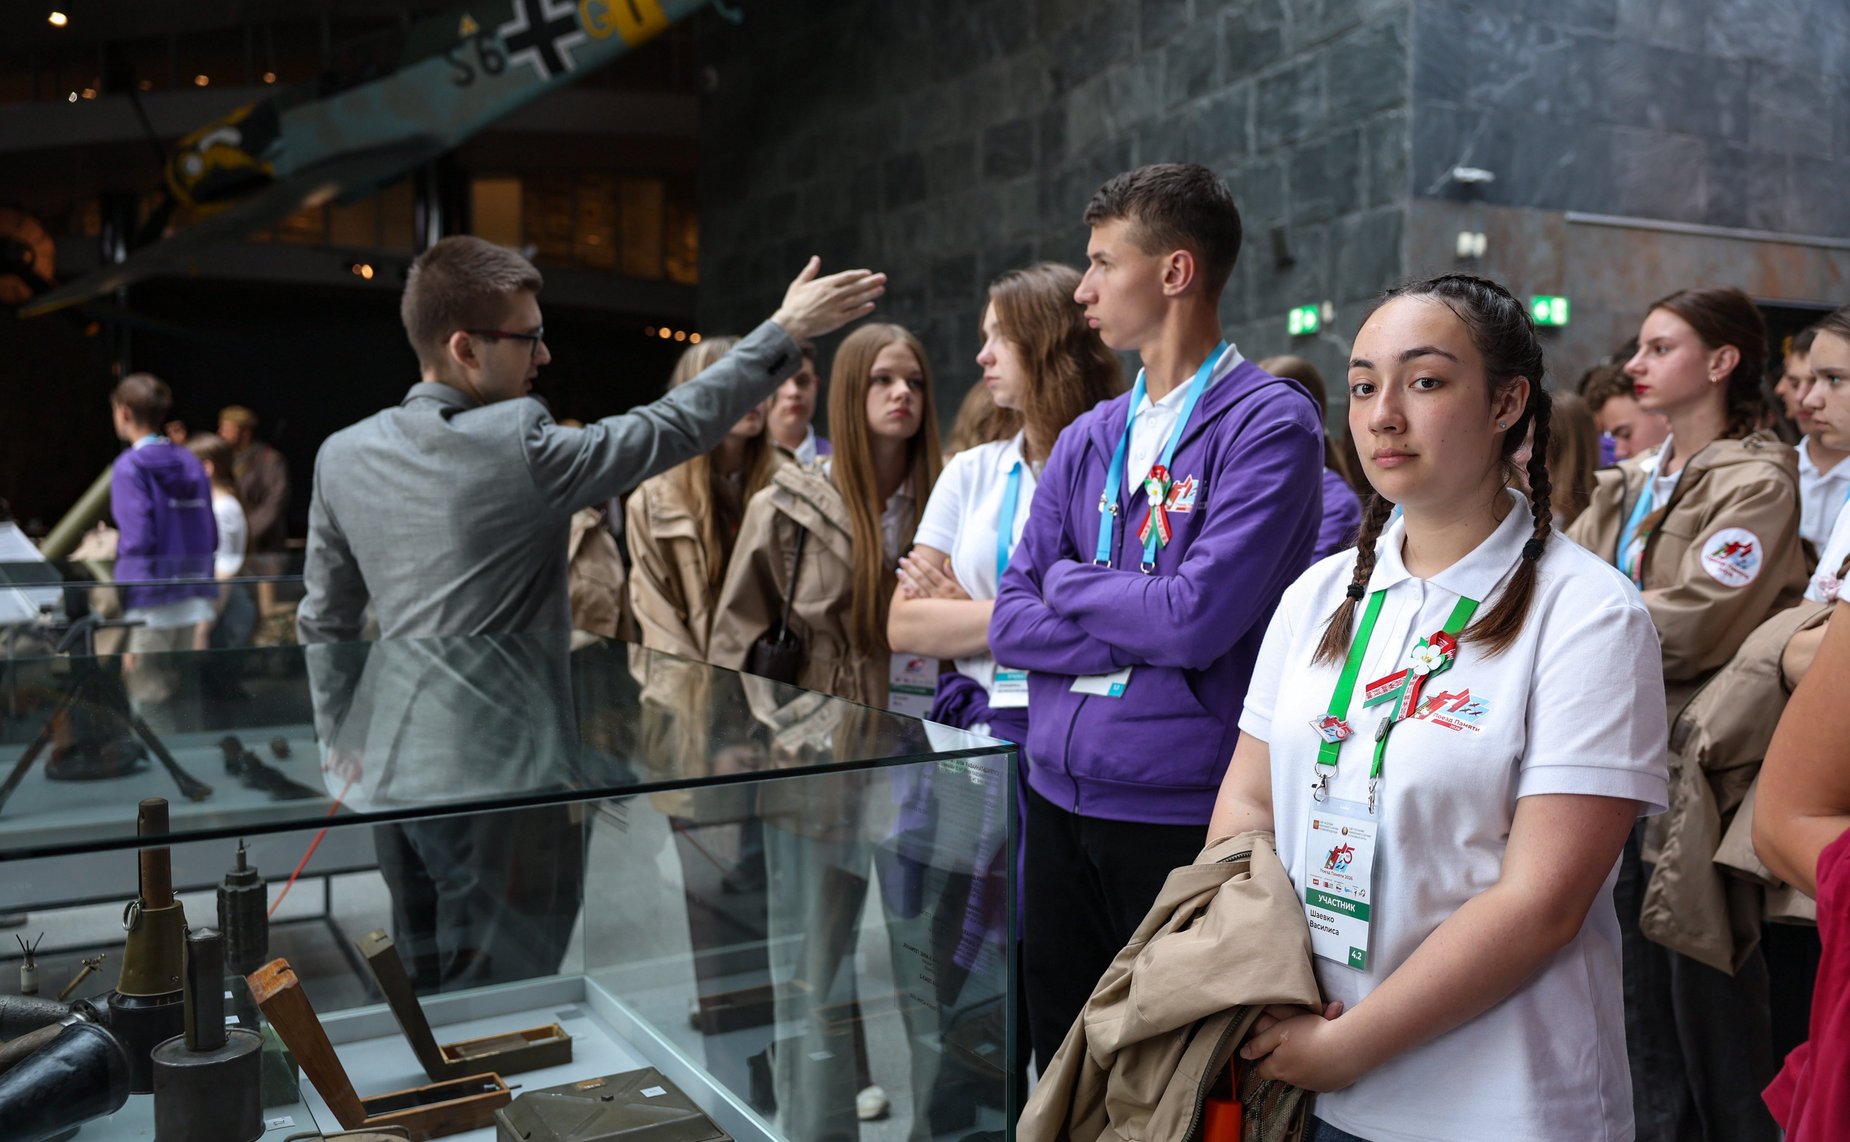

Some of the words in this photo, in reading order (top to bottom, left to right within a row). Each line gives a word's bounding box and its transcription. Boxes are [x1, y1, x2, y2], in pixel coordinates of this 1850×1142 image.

[444, 34, 505, 86] S6
[1433, 712, 1453, 724] Поезд
[1454, 719, 1480, 732] Памяти
[1318, 894, 1356, 912] УЧАСТНИК
[1310, 909, 1335, 923] Шаевко
[1309, 920, 1340, 936] Василиса
[1351, 950, 1362, 961] 4.2
